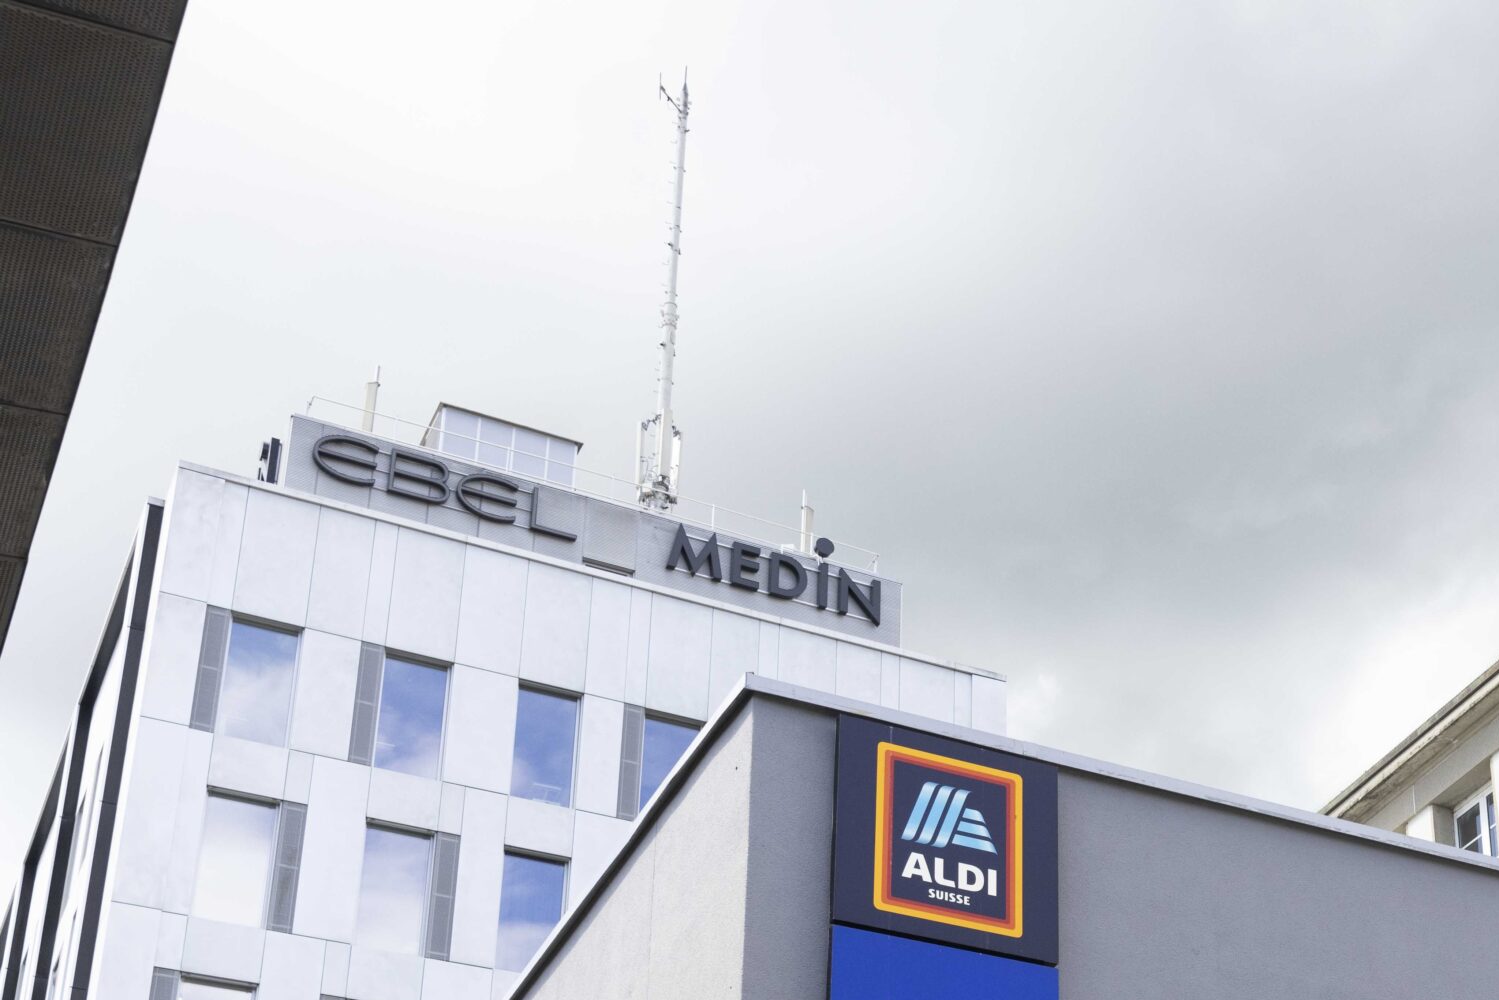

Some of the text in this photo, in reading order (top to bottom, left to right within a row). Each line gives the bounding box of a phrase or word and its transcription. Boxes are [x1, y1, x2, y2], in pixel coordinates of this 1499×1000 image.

[312, 434, 577, 542] EBEL
[666, 523, 881, 627] MEDIN
[901, 852, 998, 897] ALDI
[928, 888, 971, 906] SUISSE
